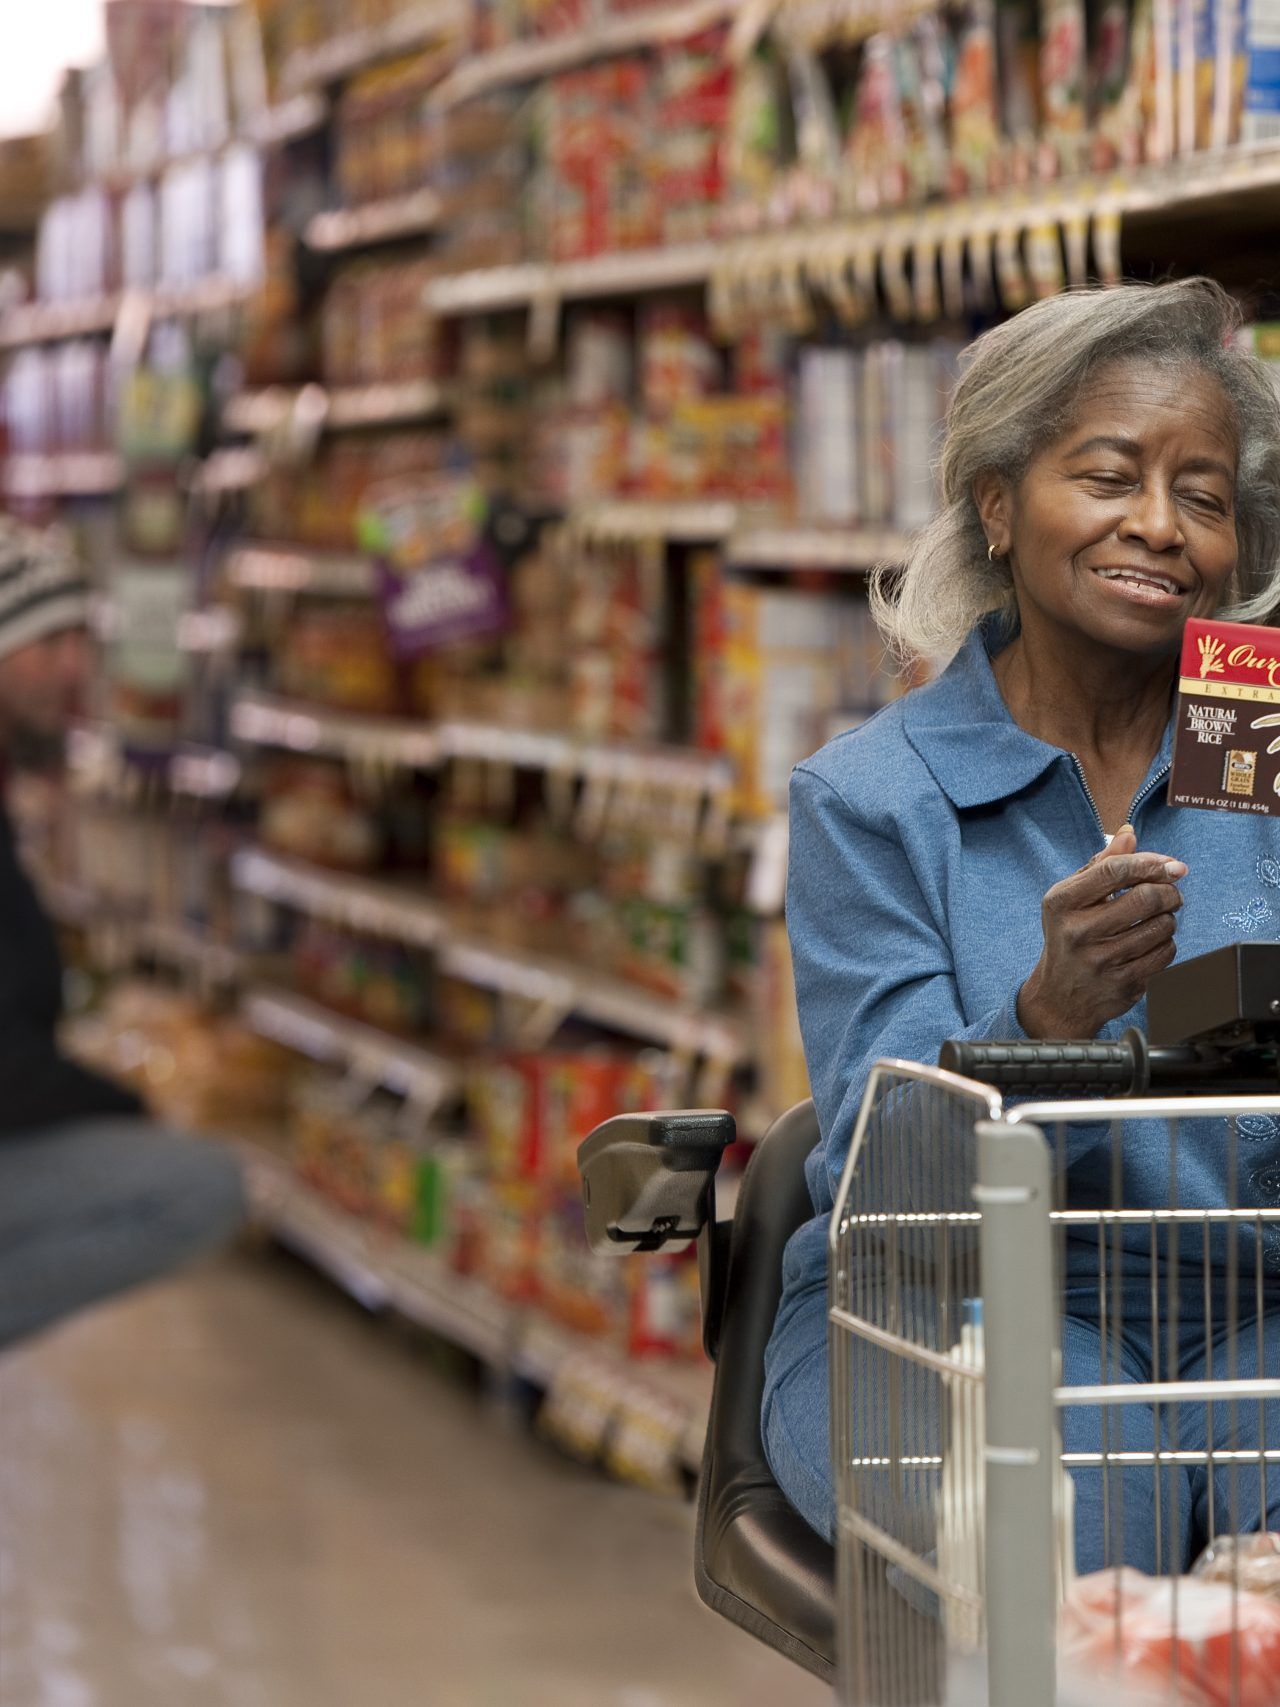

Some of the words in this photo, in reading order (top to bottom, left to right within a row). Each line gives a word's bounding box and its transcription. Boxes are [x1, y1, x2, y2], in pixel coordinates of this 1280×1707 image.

[1227, 644, 1277, 670] Our
[1205, 684, 1274, 701] EXTRA
[1188, 704, 1237, 720] NATURAL
[1190, 718, 1232, 733] BROWN
[1197, 731, 1222, 744] RICE
[1174, 795, 1190, 803] NET
[1191, 796, 1204, 804] WT
[1206, 798, 1215, 806] 16
[1251, 803, 1269, 813] 454g
